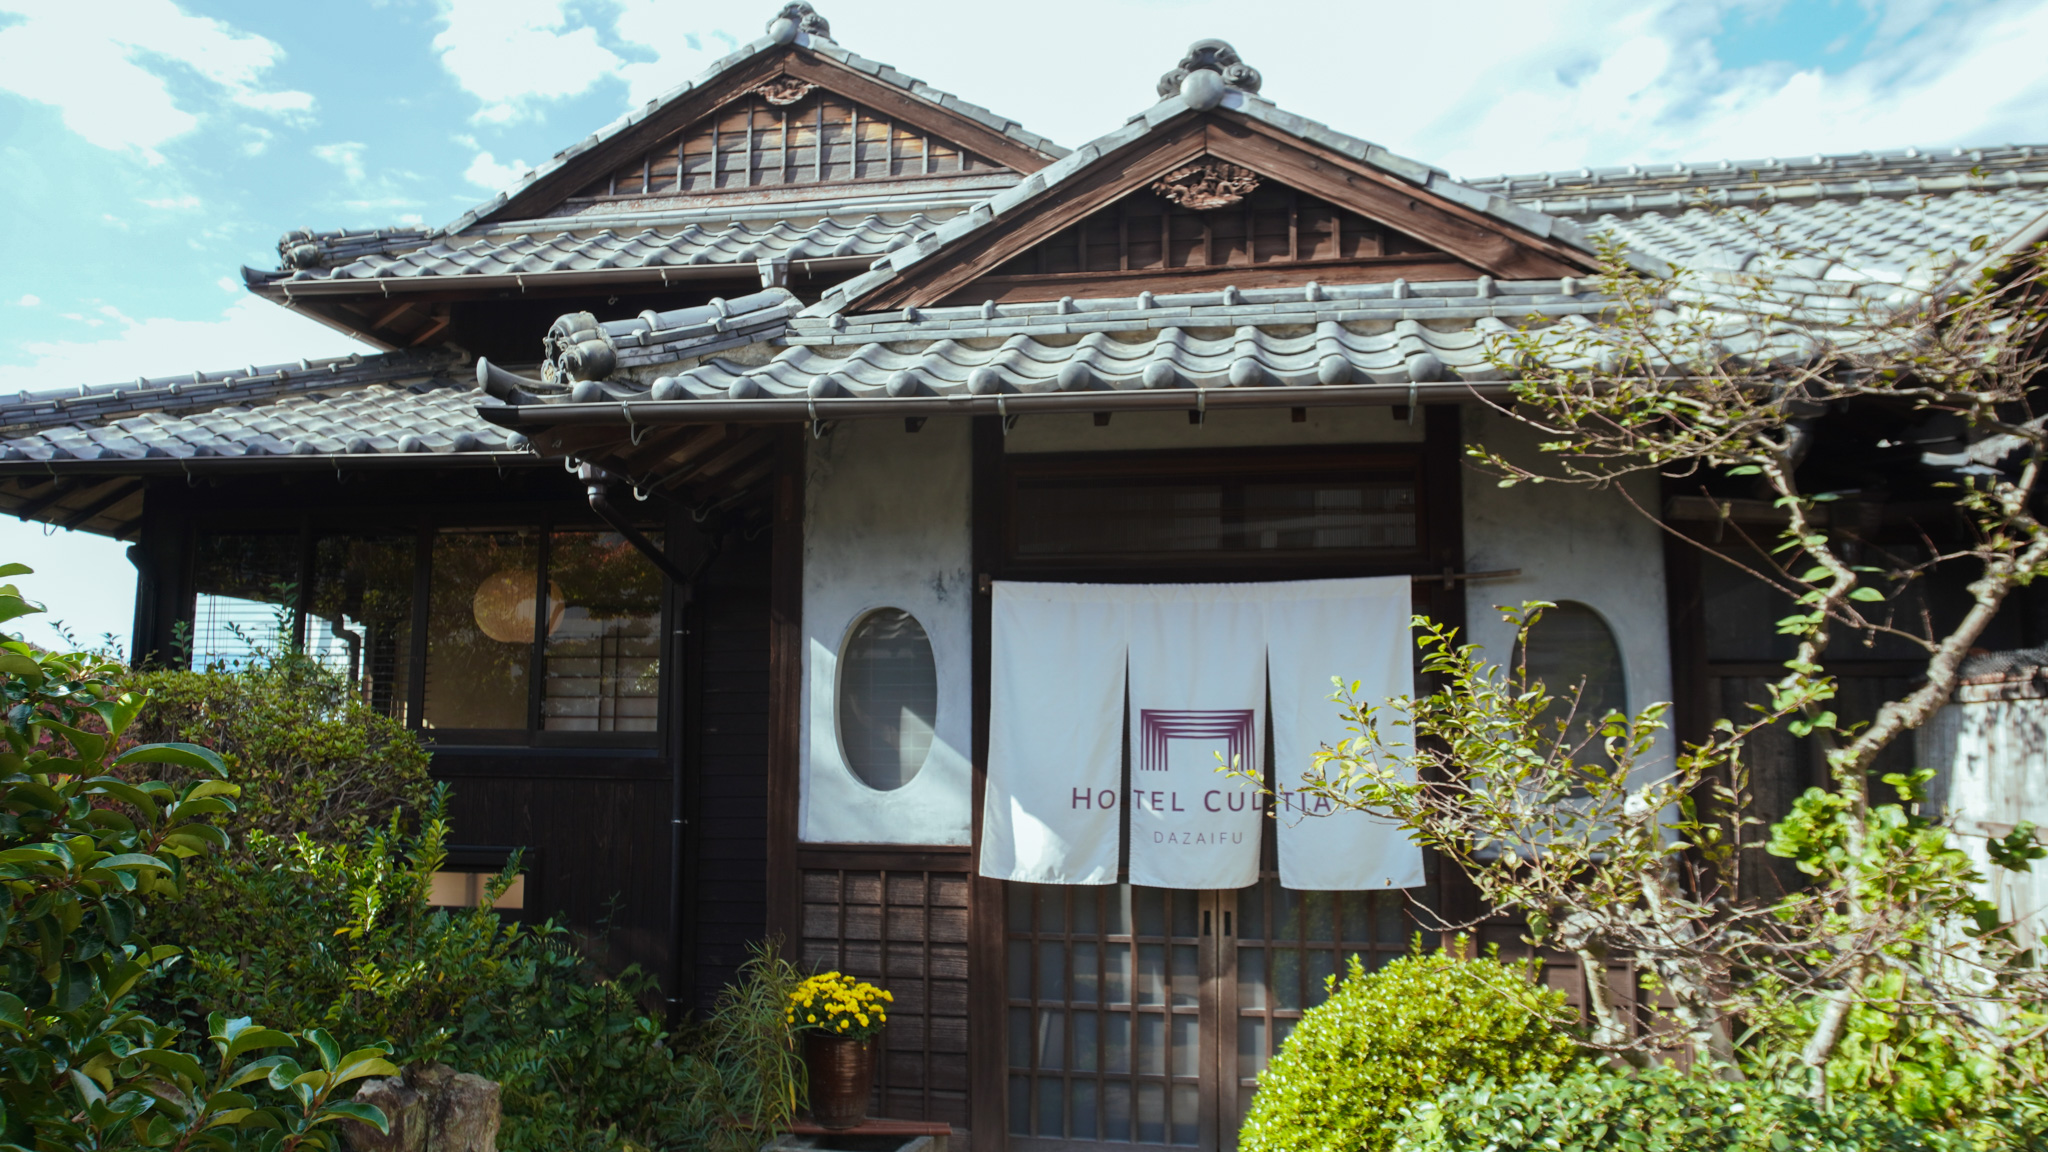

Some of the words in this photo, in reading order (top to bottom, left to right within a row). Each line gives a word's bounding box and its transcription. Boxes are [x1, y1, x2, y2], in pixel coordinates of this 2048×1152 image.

[1071, 786, 1185, 812] HOTEL
[1203, 789, 1331, 812] CULTIA
[1153, 830, 1244, 845] DAZAIFU
